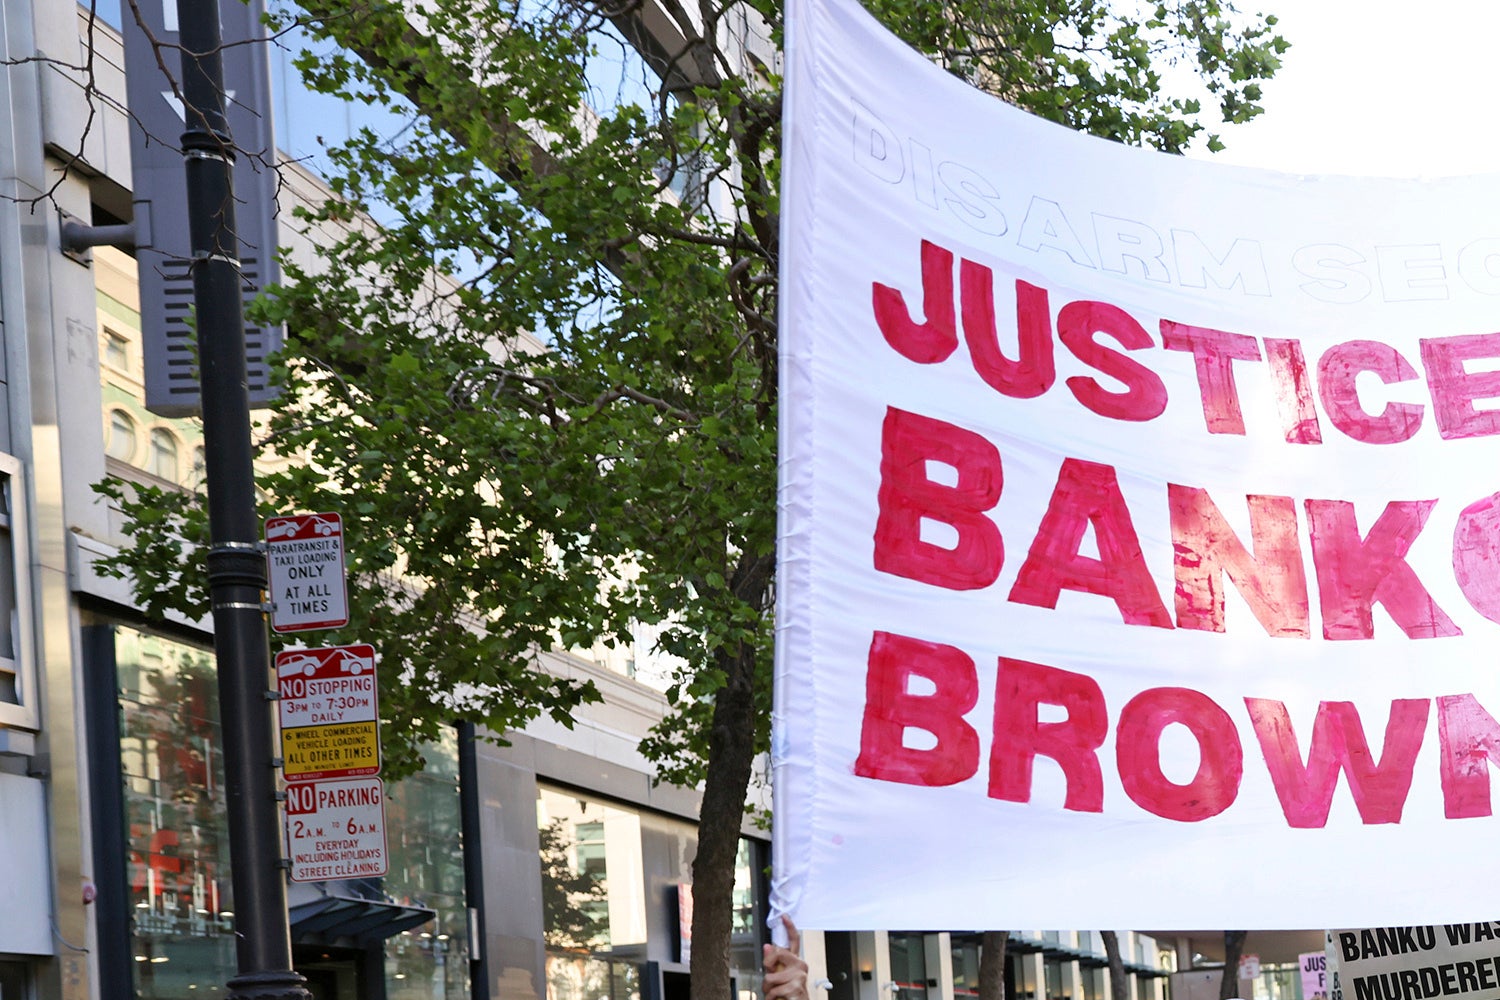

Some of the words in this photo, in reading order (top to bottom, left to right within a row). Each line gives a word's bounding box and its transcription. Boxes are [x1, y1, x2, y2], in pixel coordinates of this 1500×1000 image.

[851, 97, 1271, 297] DISARM
[271, 540, 330, 555] PARATRANSIT
[275, 556, 295, 567] TAXI
[298, 552, 337, 565] LOADING
[288, 564, 325, 580] ONLY
[285, 586, 300, 600] AT
[308, 584, 331, 598] ALL
[290, 600, 328, 615] TIMES
[281, 679, 305, 699] NO
[309, 678, 371, 696] STOPPING
[312, 711, 344, 723] DAILY
[295, 729, 320, 739] WHEEL
[323, 726, 373, 738] COMMERCIAL
[297, 740, 329, 750] VEHICLE
[333, 736, 366, 748] LOADING
[288, 752, 305, 764] ALL
[310, 749, 340, 762] OTHER
[344, 747, 373, 759] TIMES
[288, 785, 314, 812] NO
[319, 786, 379, 809] PARKING
[315, 839, 359, 852] EVERYDAY
[295, 852, 339, 864] INCLUDING
[341, 848, 381, 860] HOLIDAYS
[299, 866, 332, 878] STREET
[335, 862, 380, 875] CLEANING
[1339, 925, 1437, 962] BANKO
